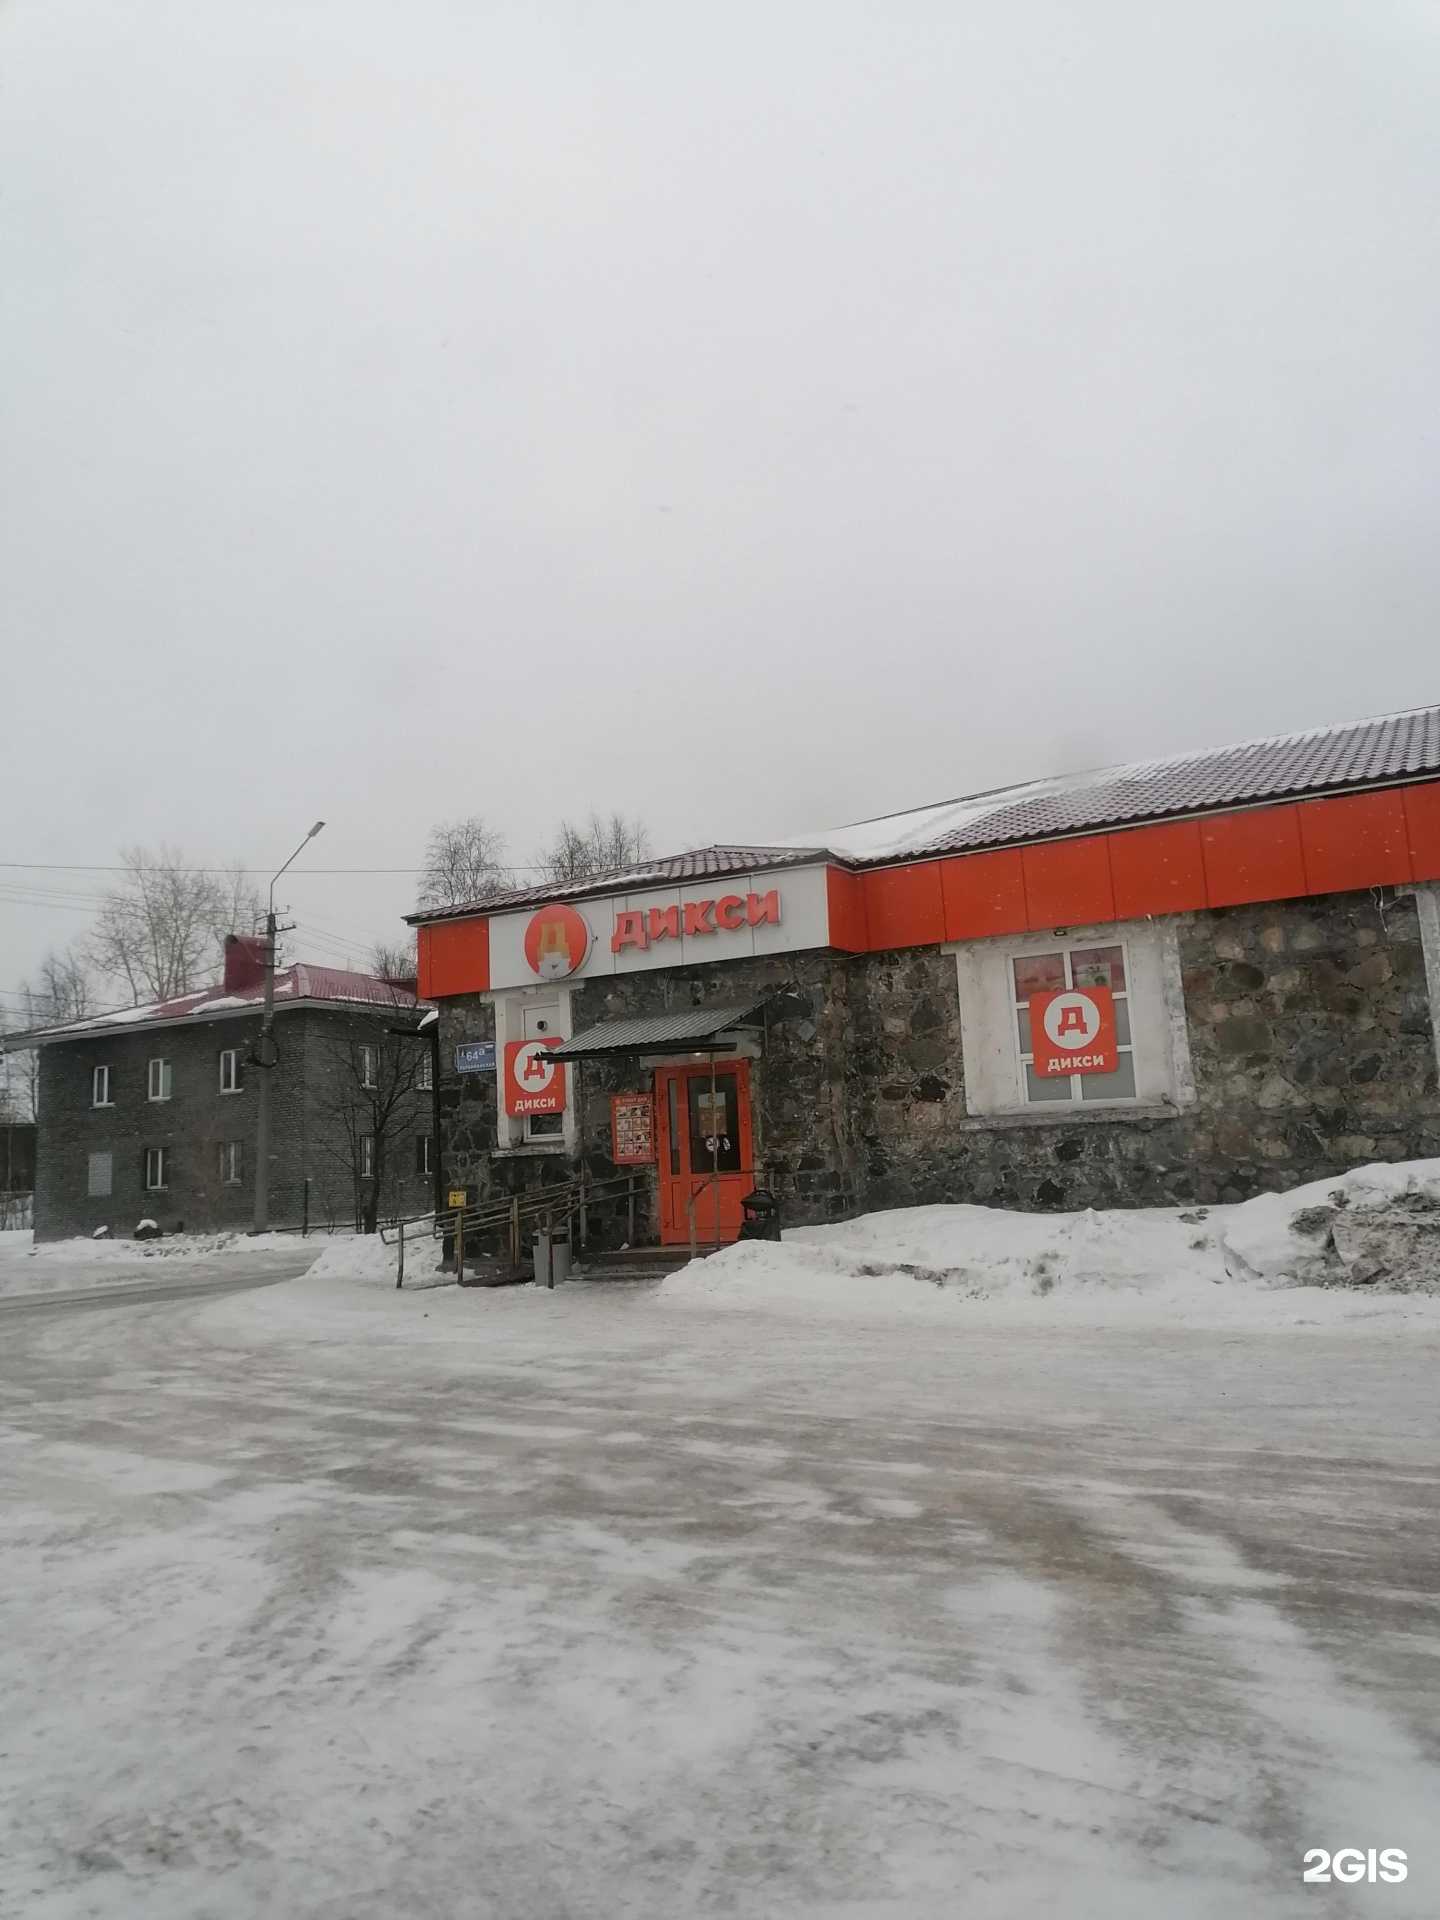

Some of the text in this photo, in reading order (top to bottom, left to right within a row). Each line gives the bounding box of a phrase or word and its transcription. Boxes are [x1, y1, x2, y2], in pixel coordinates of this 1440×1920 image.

[611, 889, 780, 953] ДИКСИ
[1057, 1006, 1088, 1037] Д
[1047, 1054, 1105, 1072] ДИКСИ
[514, 1097, 556, 1112] ДИКСИ
